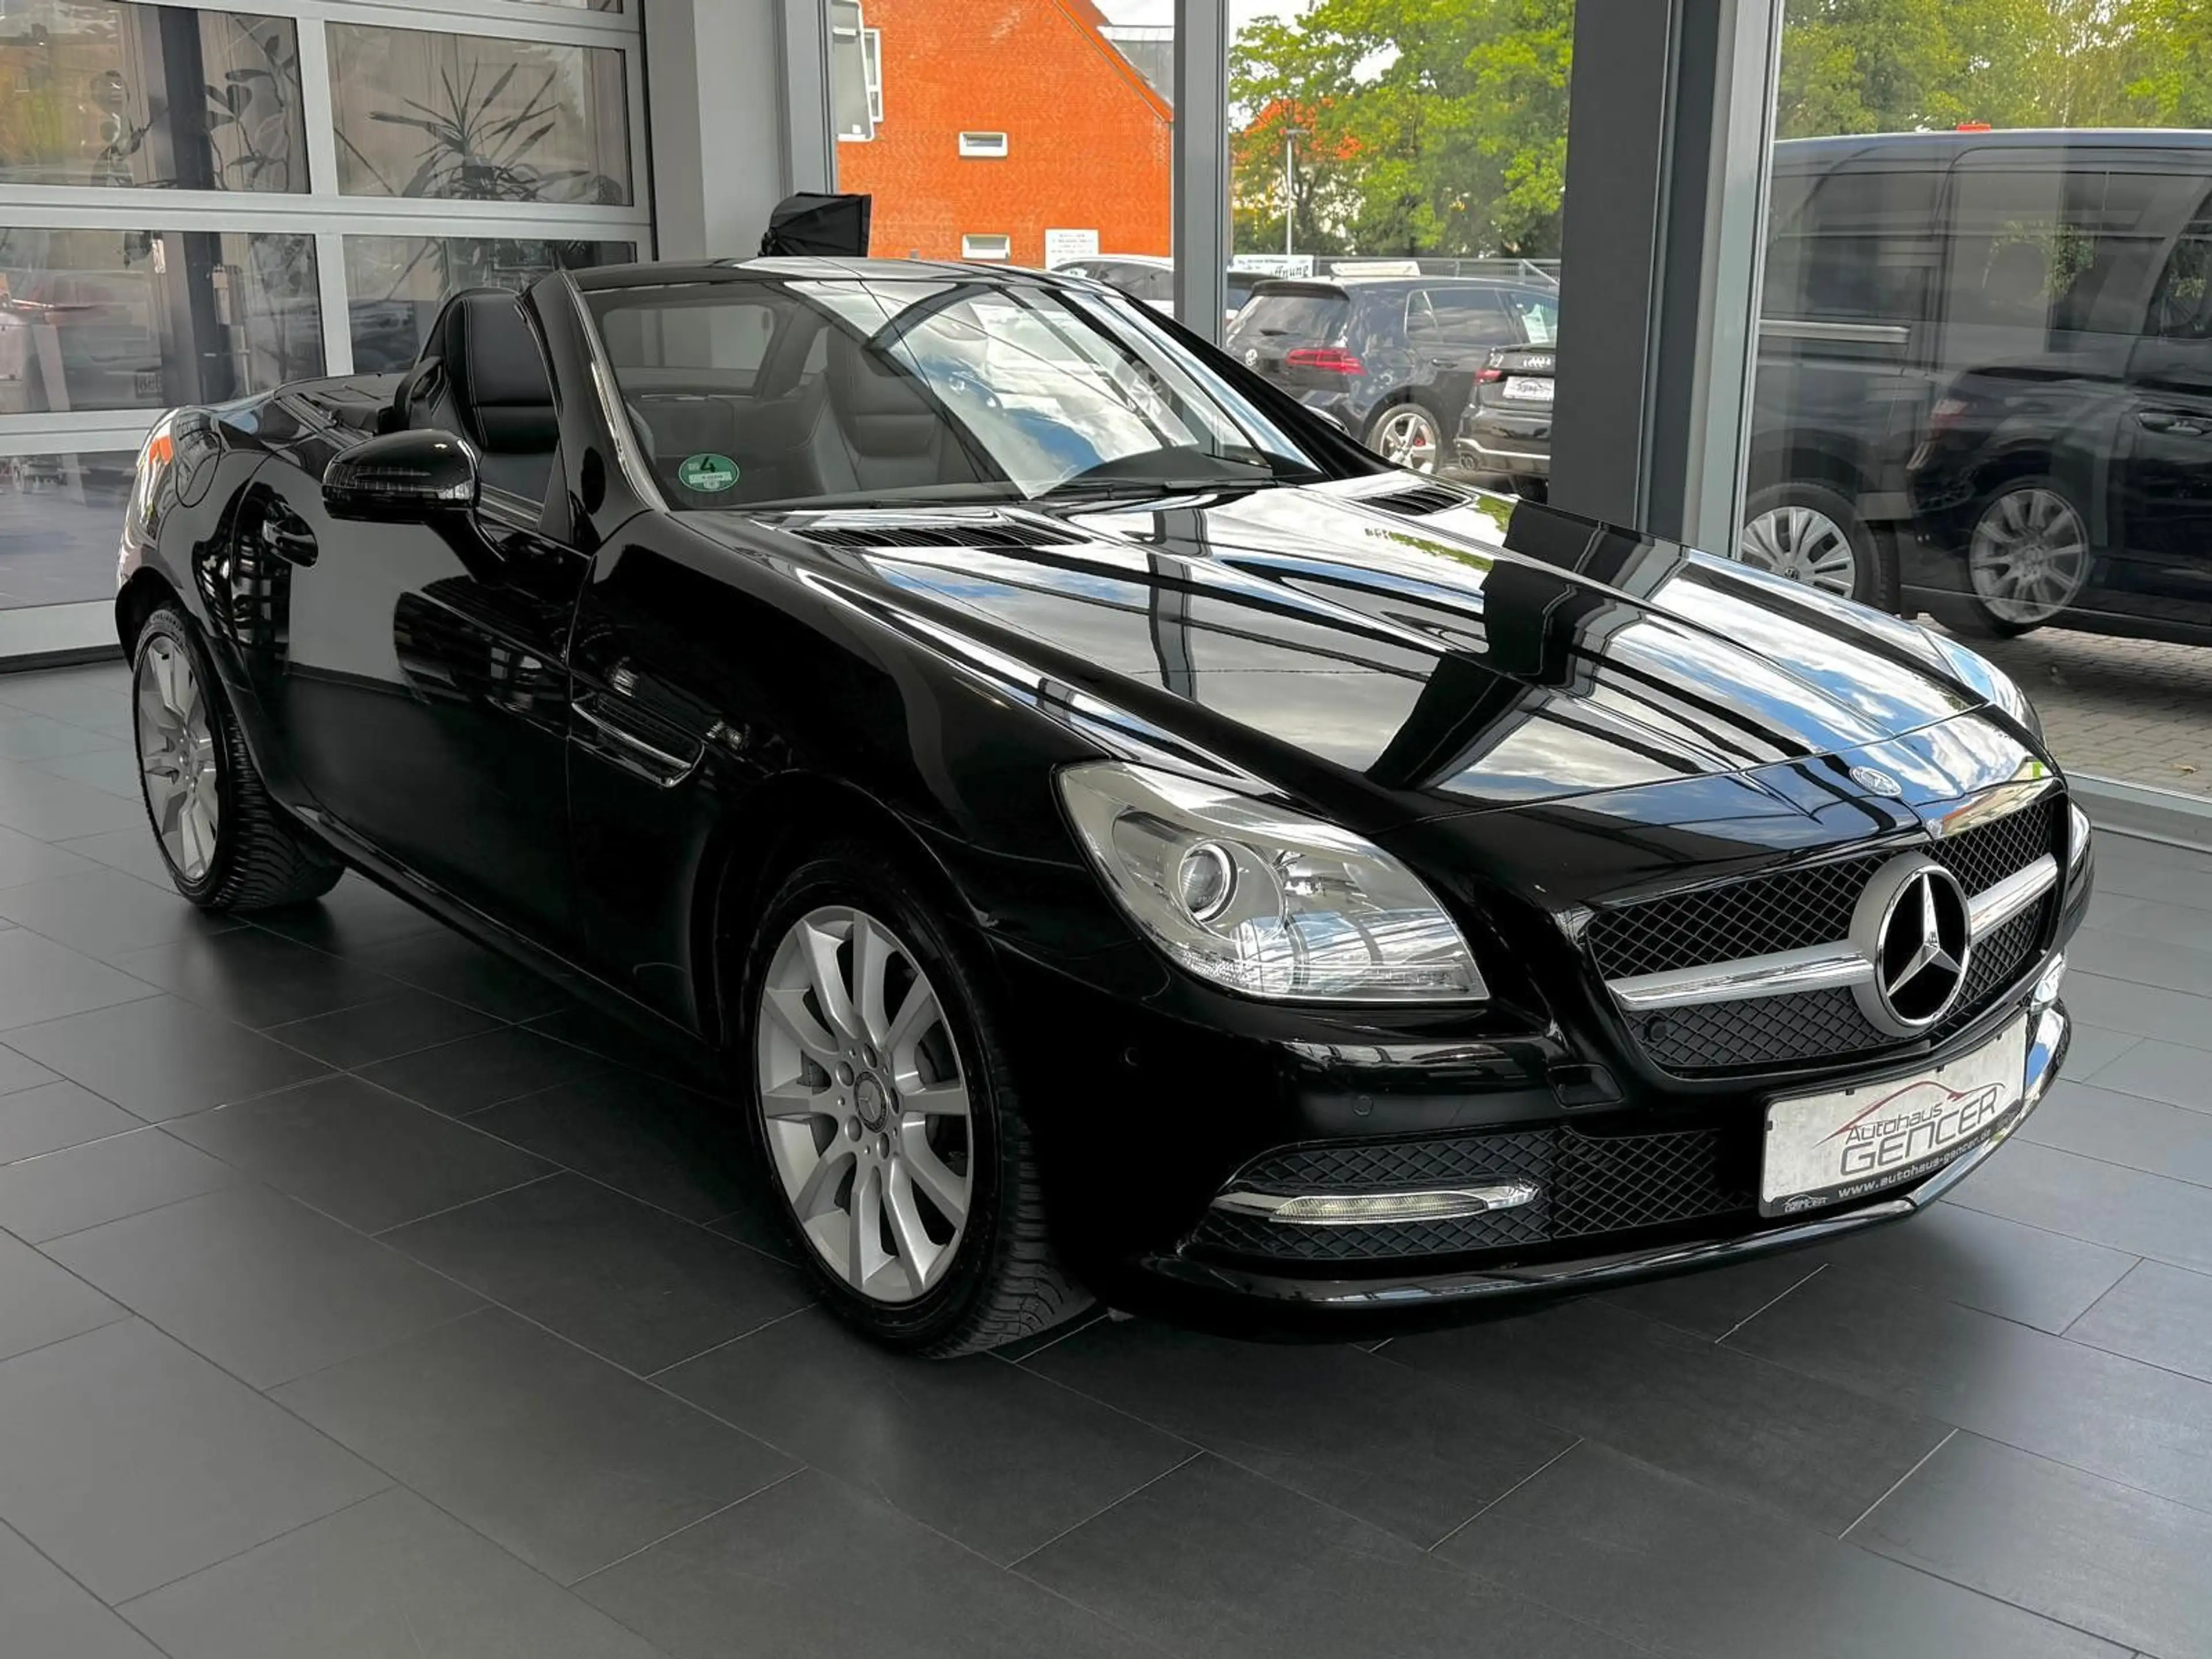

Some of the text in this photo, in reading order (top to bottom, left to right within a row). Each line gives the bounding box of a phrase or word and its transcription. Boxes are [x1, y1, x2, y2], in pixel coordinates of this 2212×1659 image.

[700, 456, 715, 472] 4
[1840, 1087, 1997, 1176] GENCER
[1846, 1101, 1943, 1145] Autohaus
[1838, 1128, 1991, 1198] www.autohaus-gencer.de
